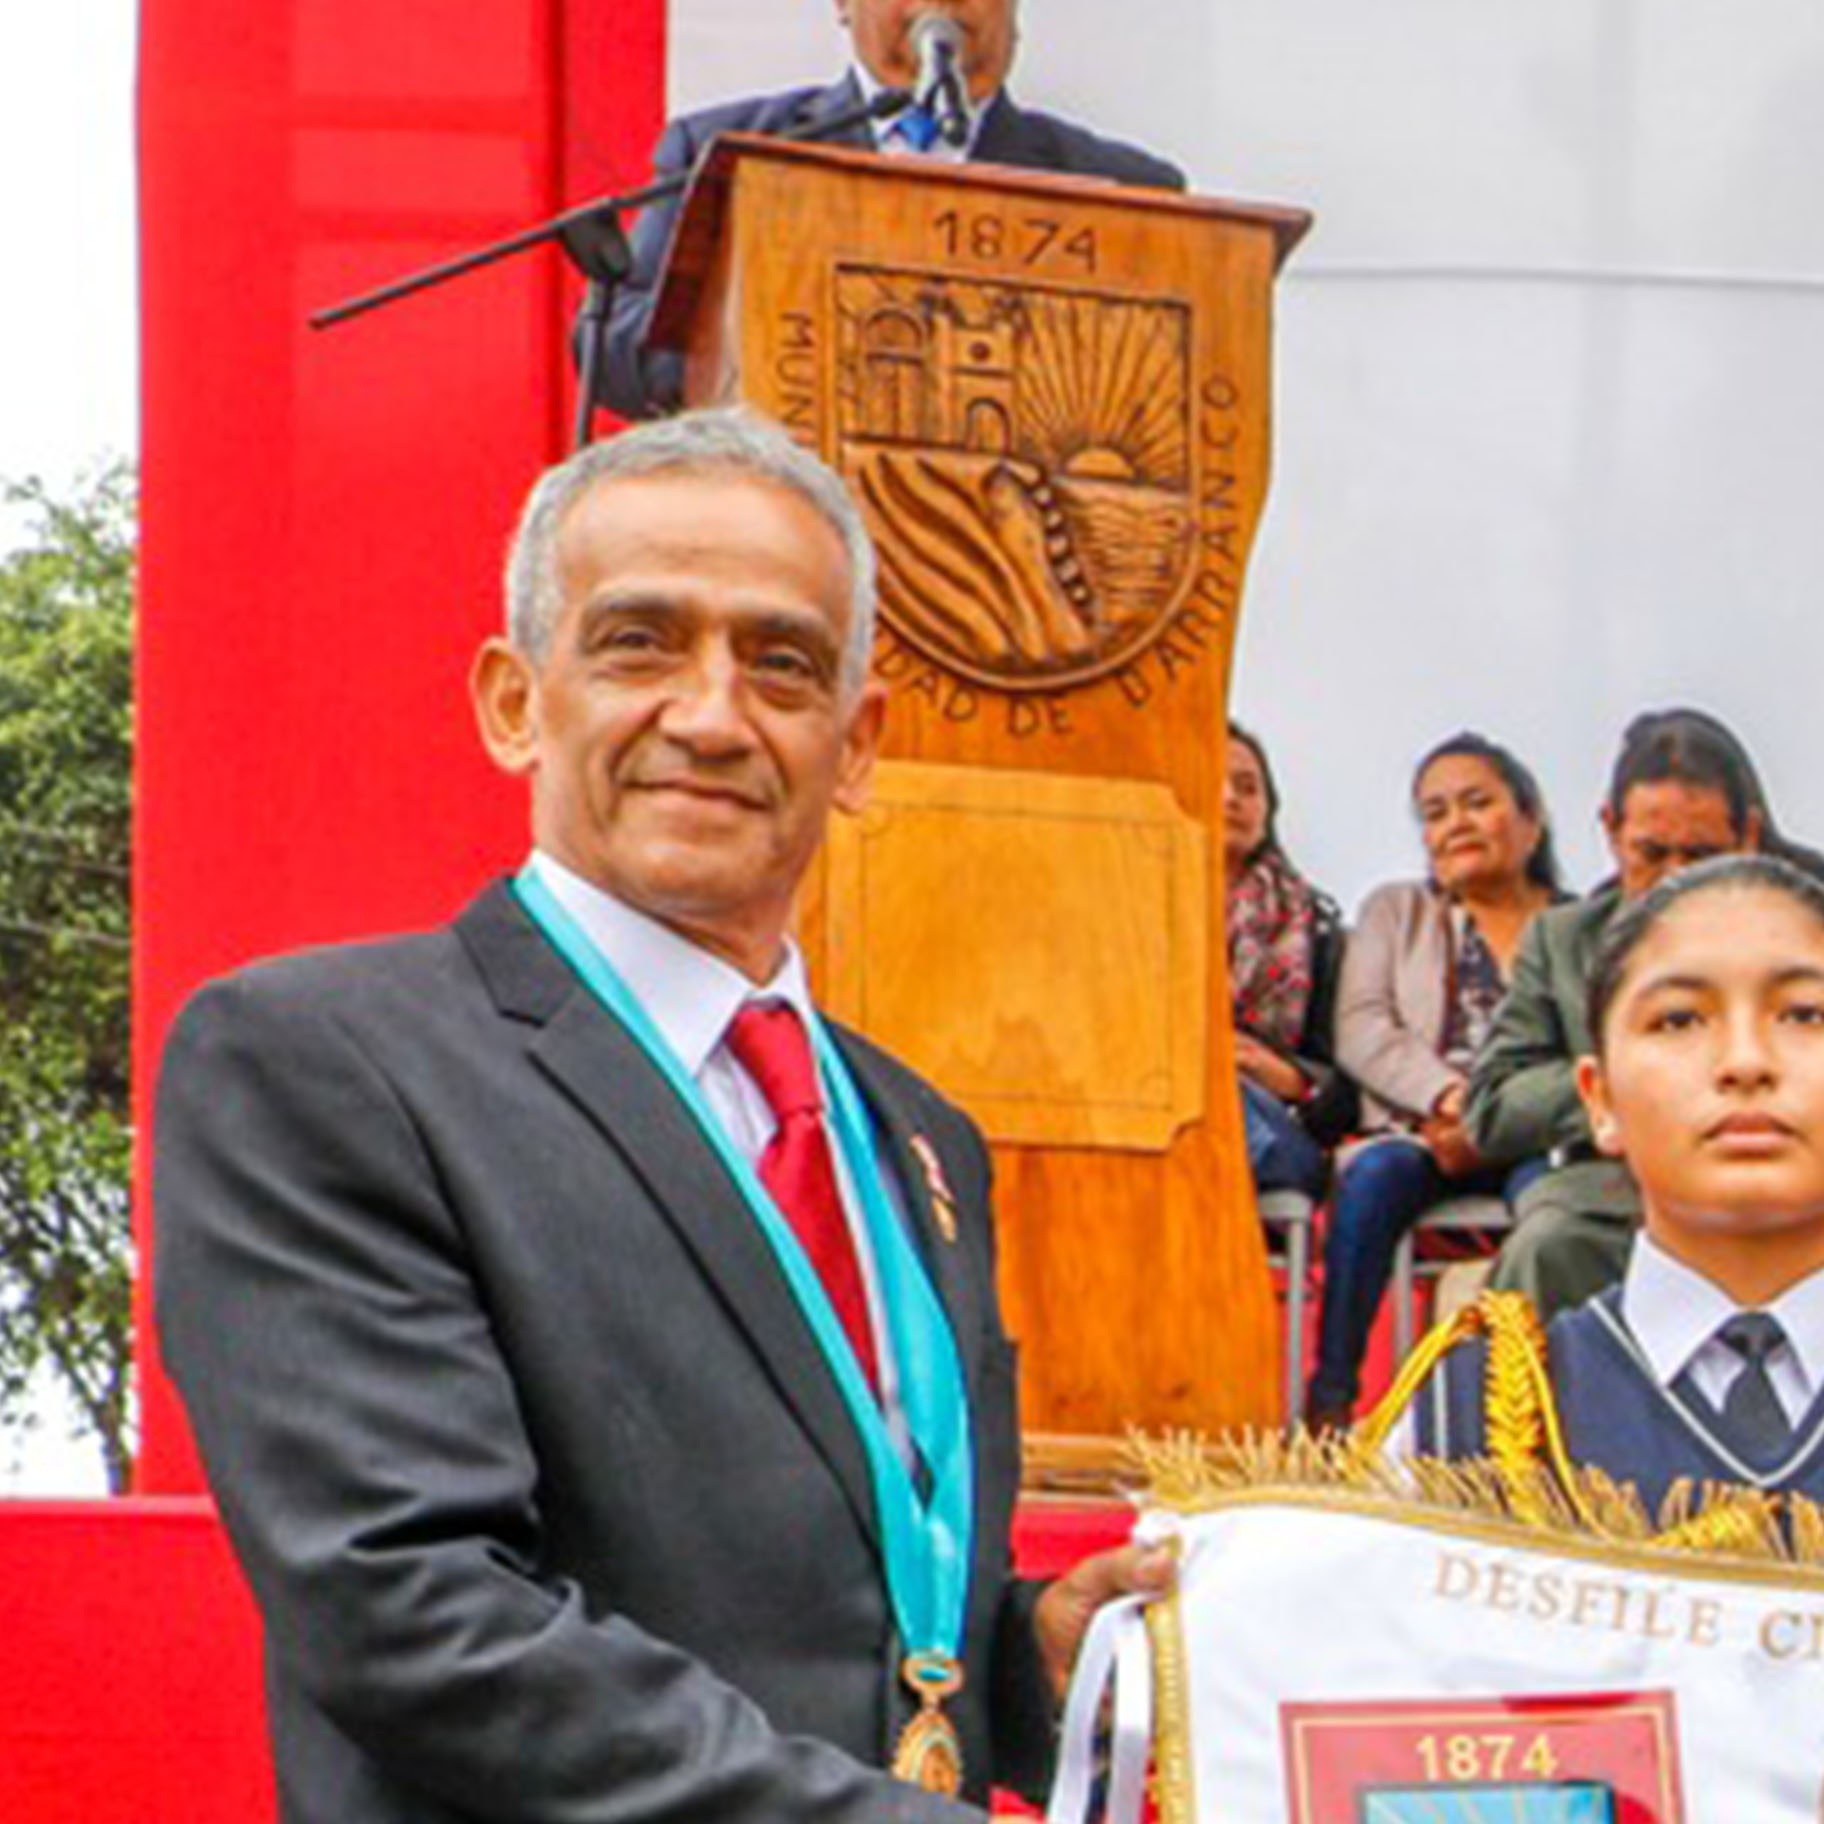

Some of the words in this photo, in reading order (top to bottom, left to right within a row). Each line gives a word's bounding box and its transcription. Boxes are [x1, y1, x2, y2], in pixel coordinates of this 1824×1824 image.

[934, 210, 1098, 274] 1874
[1007, 696, 1075, 738] DE
[1433, 1553, 1724, 1647] DESFILE
[1417, 1734, 1558, 1781] 1874
